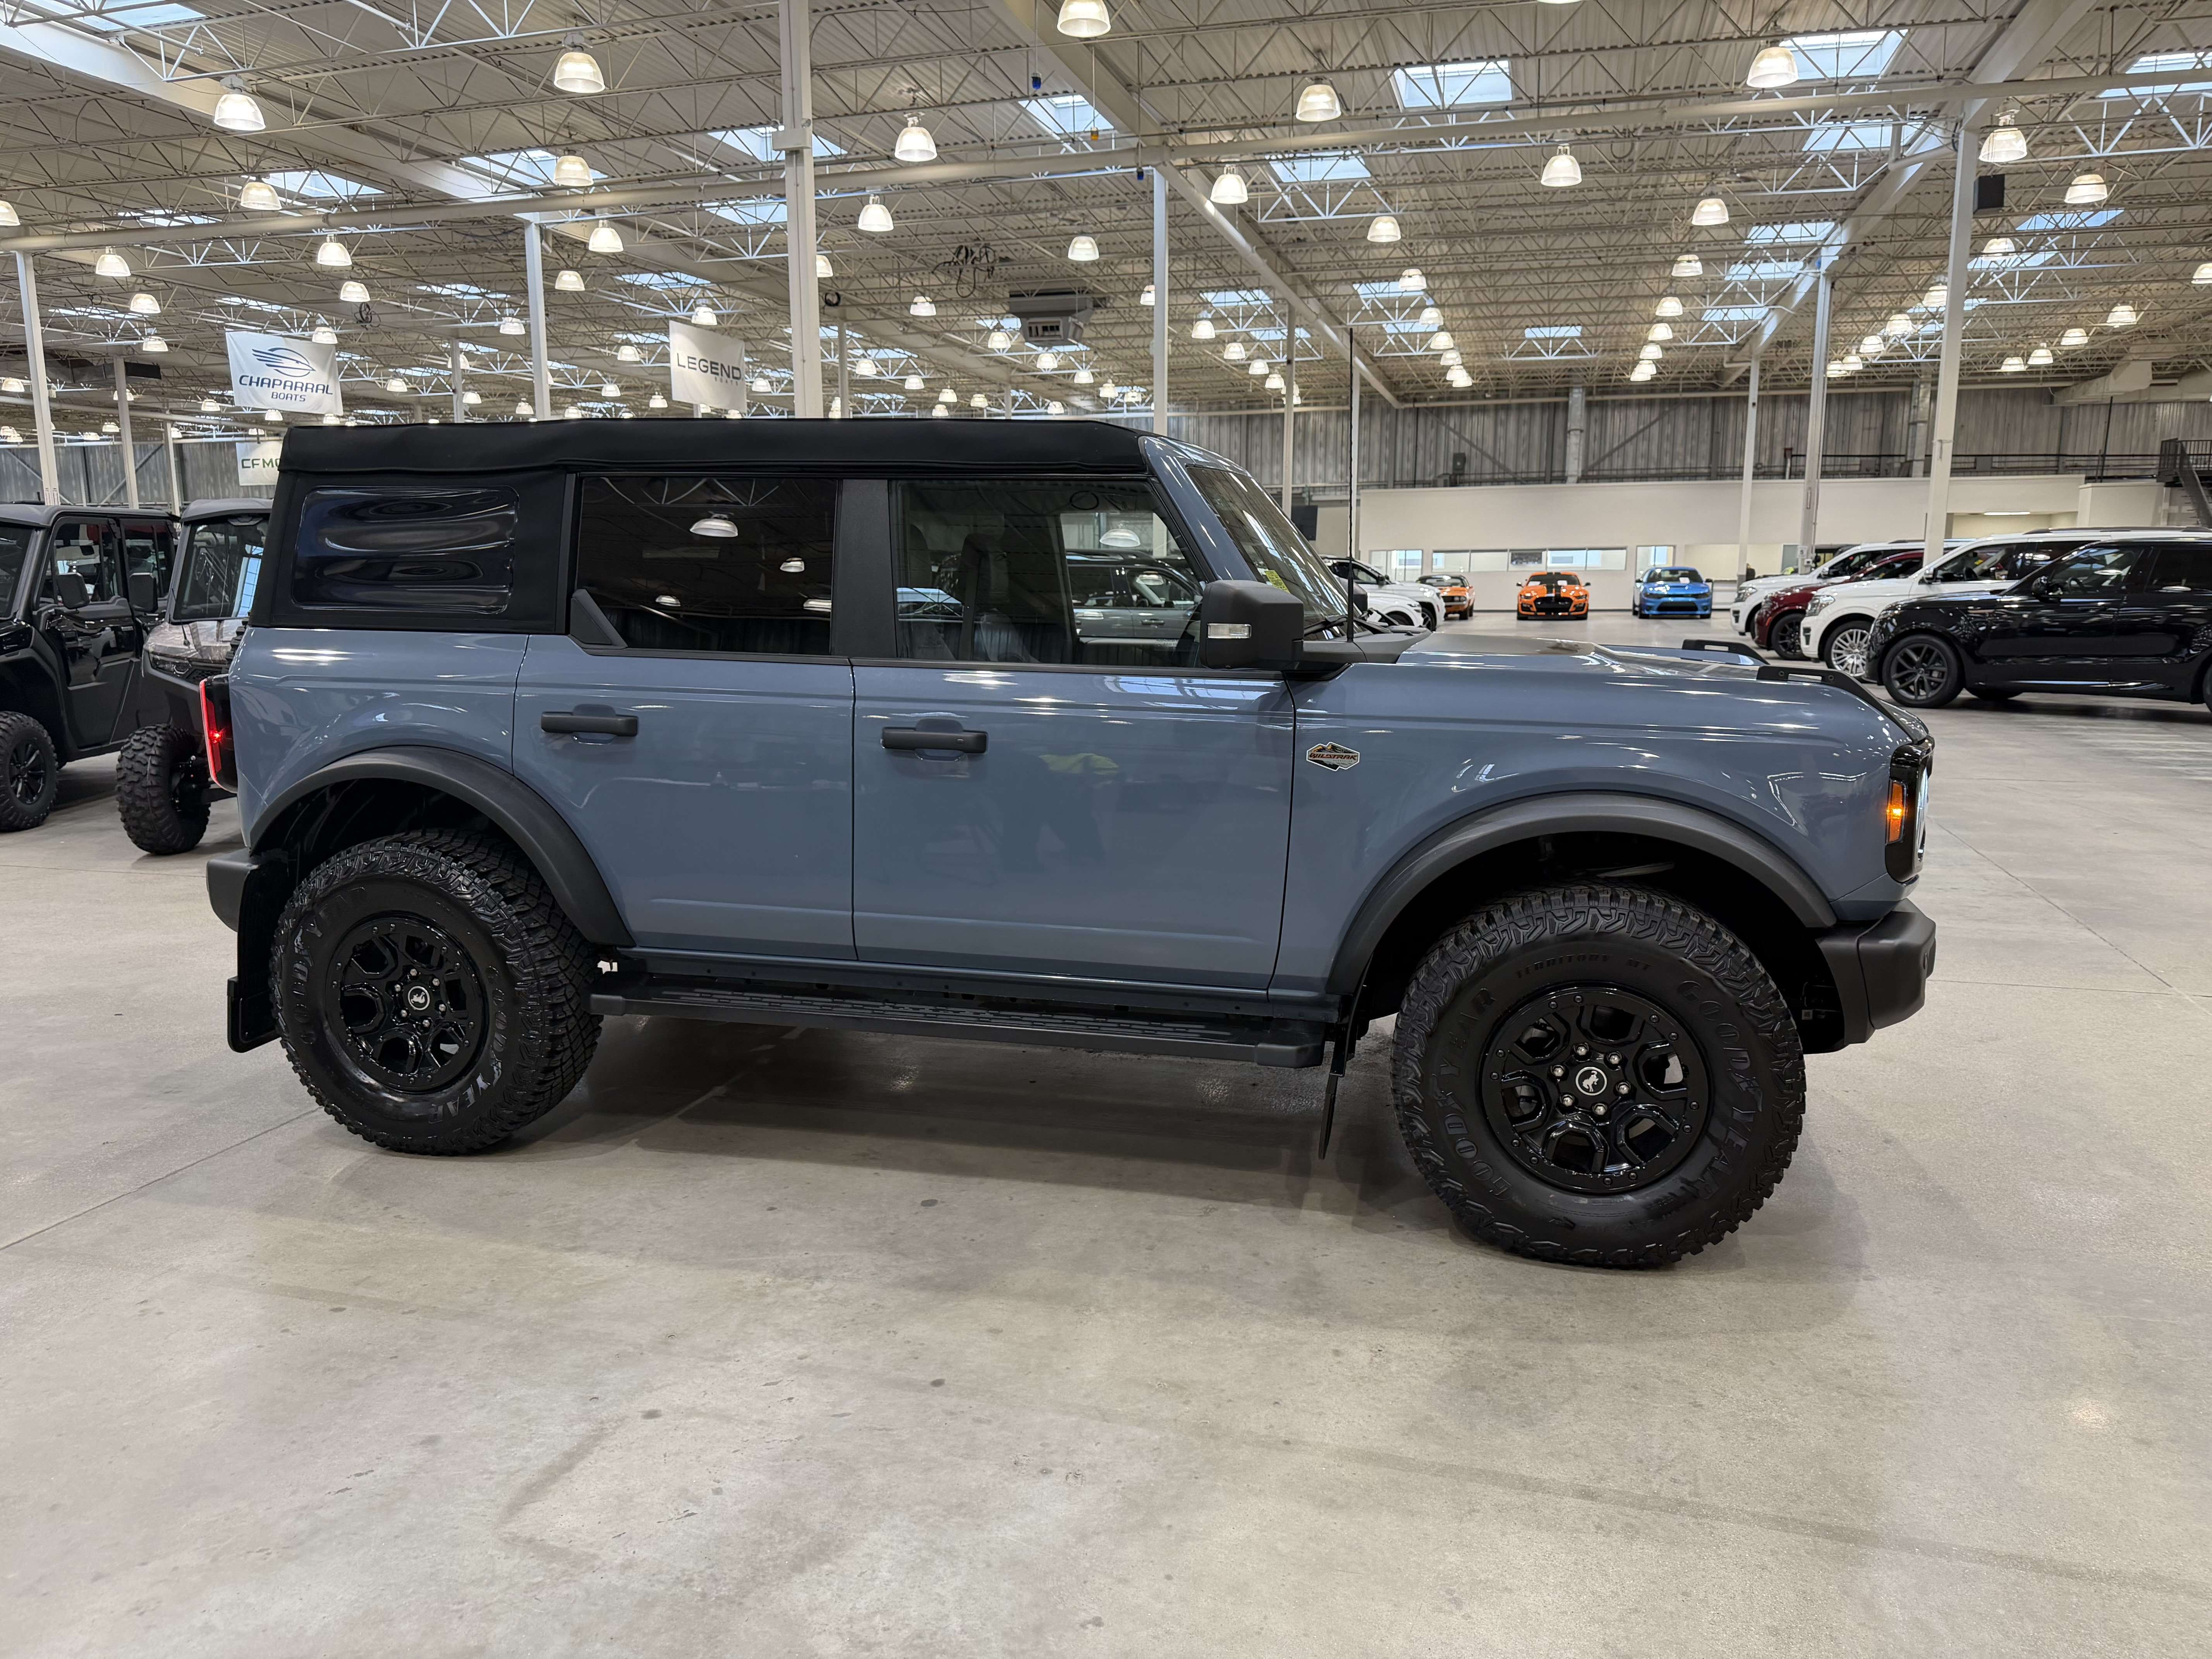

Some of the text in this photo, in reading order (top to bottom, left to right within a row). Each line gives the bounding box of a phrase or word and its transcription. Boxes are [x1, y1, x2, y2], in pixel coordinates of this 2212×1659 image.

[677, 352, 741, 380] LEGEND
[239, 375, 333, 395] CHAPARRAL
[271, 392, 306, 402] BOATS
[1515, 953, 1613, 978] TERRITORY
[429, 965, 507, 1124] GOODYEAR
[1431, 988, 1513, 1202] GOODYEAR
[1678, 980, 1763, 1199] GOODYEAR
